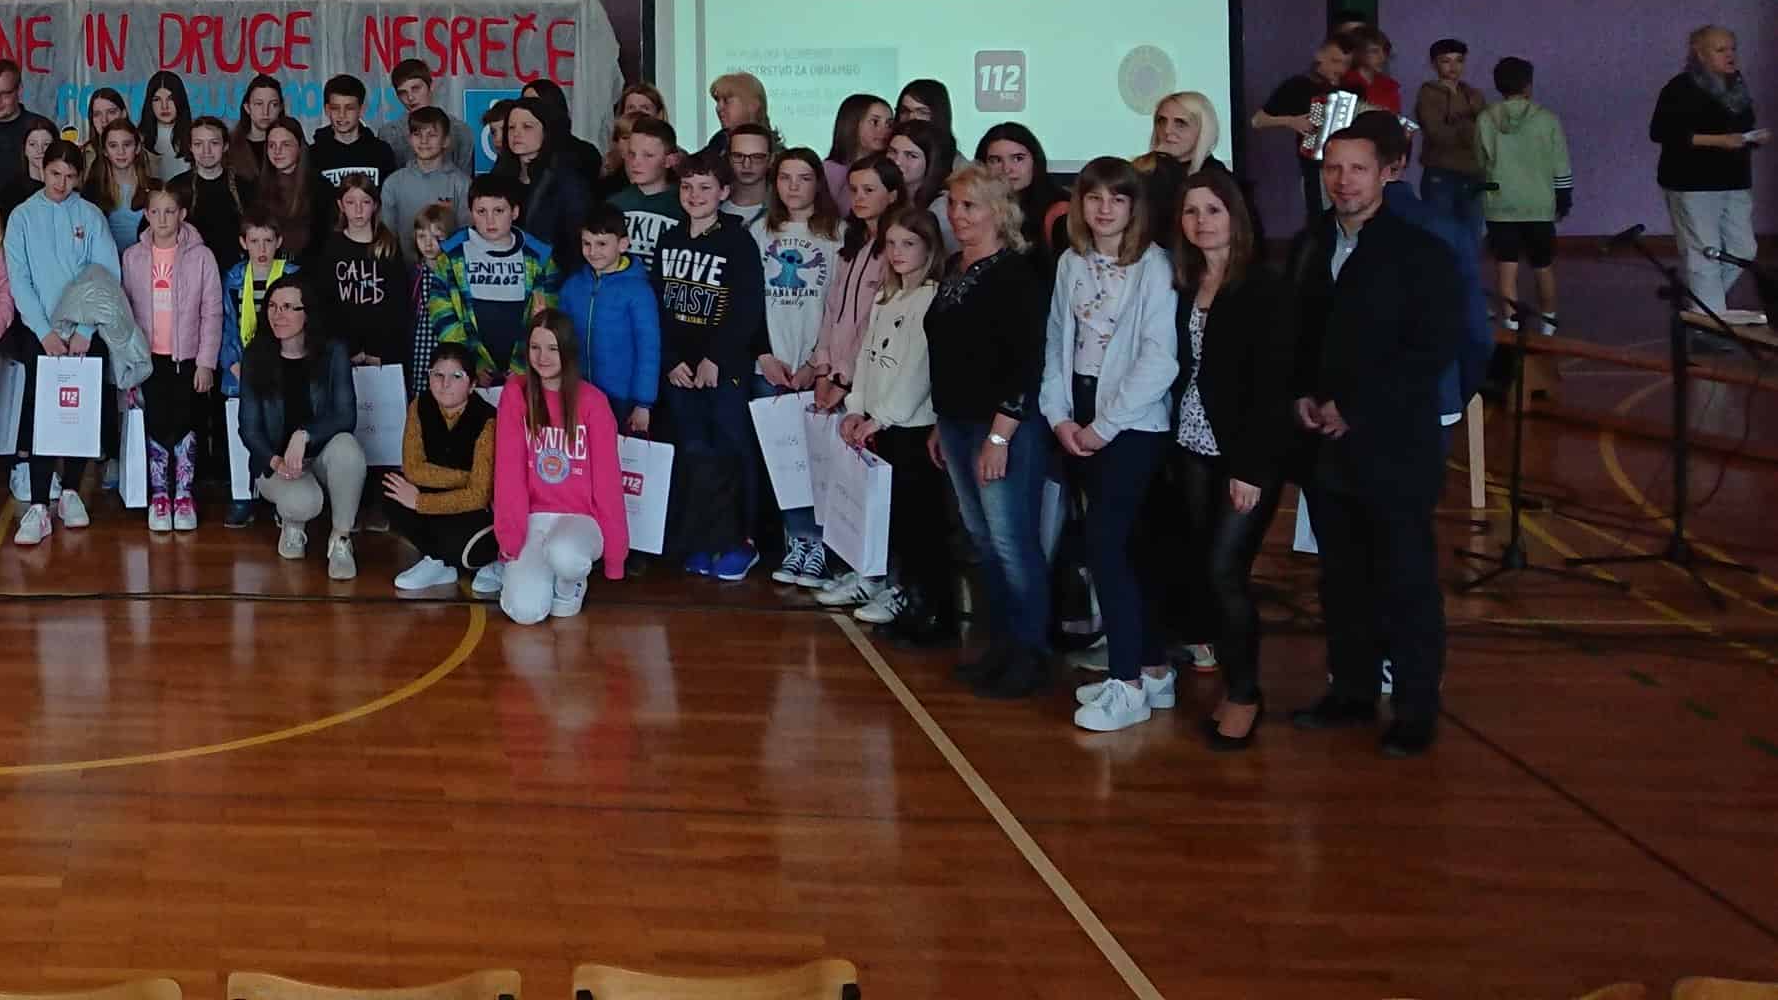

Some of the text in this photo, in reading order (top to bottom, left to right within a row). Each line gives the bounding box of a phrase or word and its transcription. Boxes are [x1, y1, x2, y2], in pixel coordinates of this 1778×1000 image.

[84, 12, 129, 73] IN
[157, 10, 313, 75] DRUGE
[363, 12, 577, 87] NESREČE
[979, 64, 1022, 92] 112
[335, 259, 385, 284] CALL
[661, 248, 727, 287] MOVE
[337, 280, 386, 305] WILD
[663, 281, 719, 317] FAST
[60, 390, 79, 402] 112
